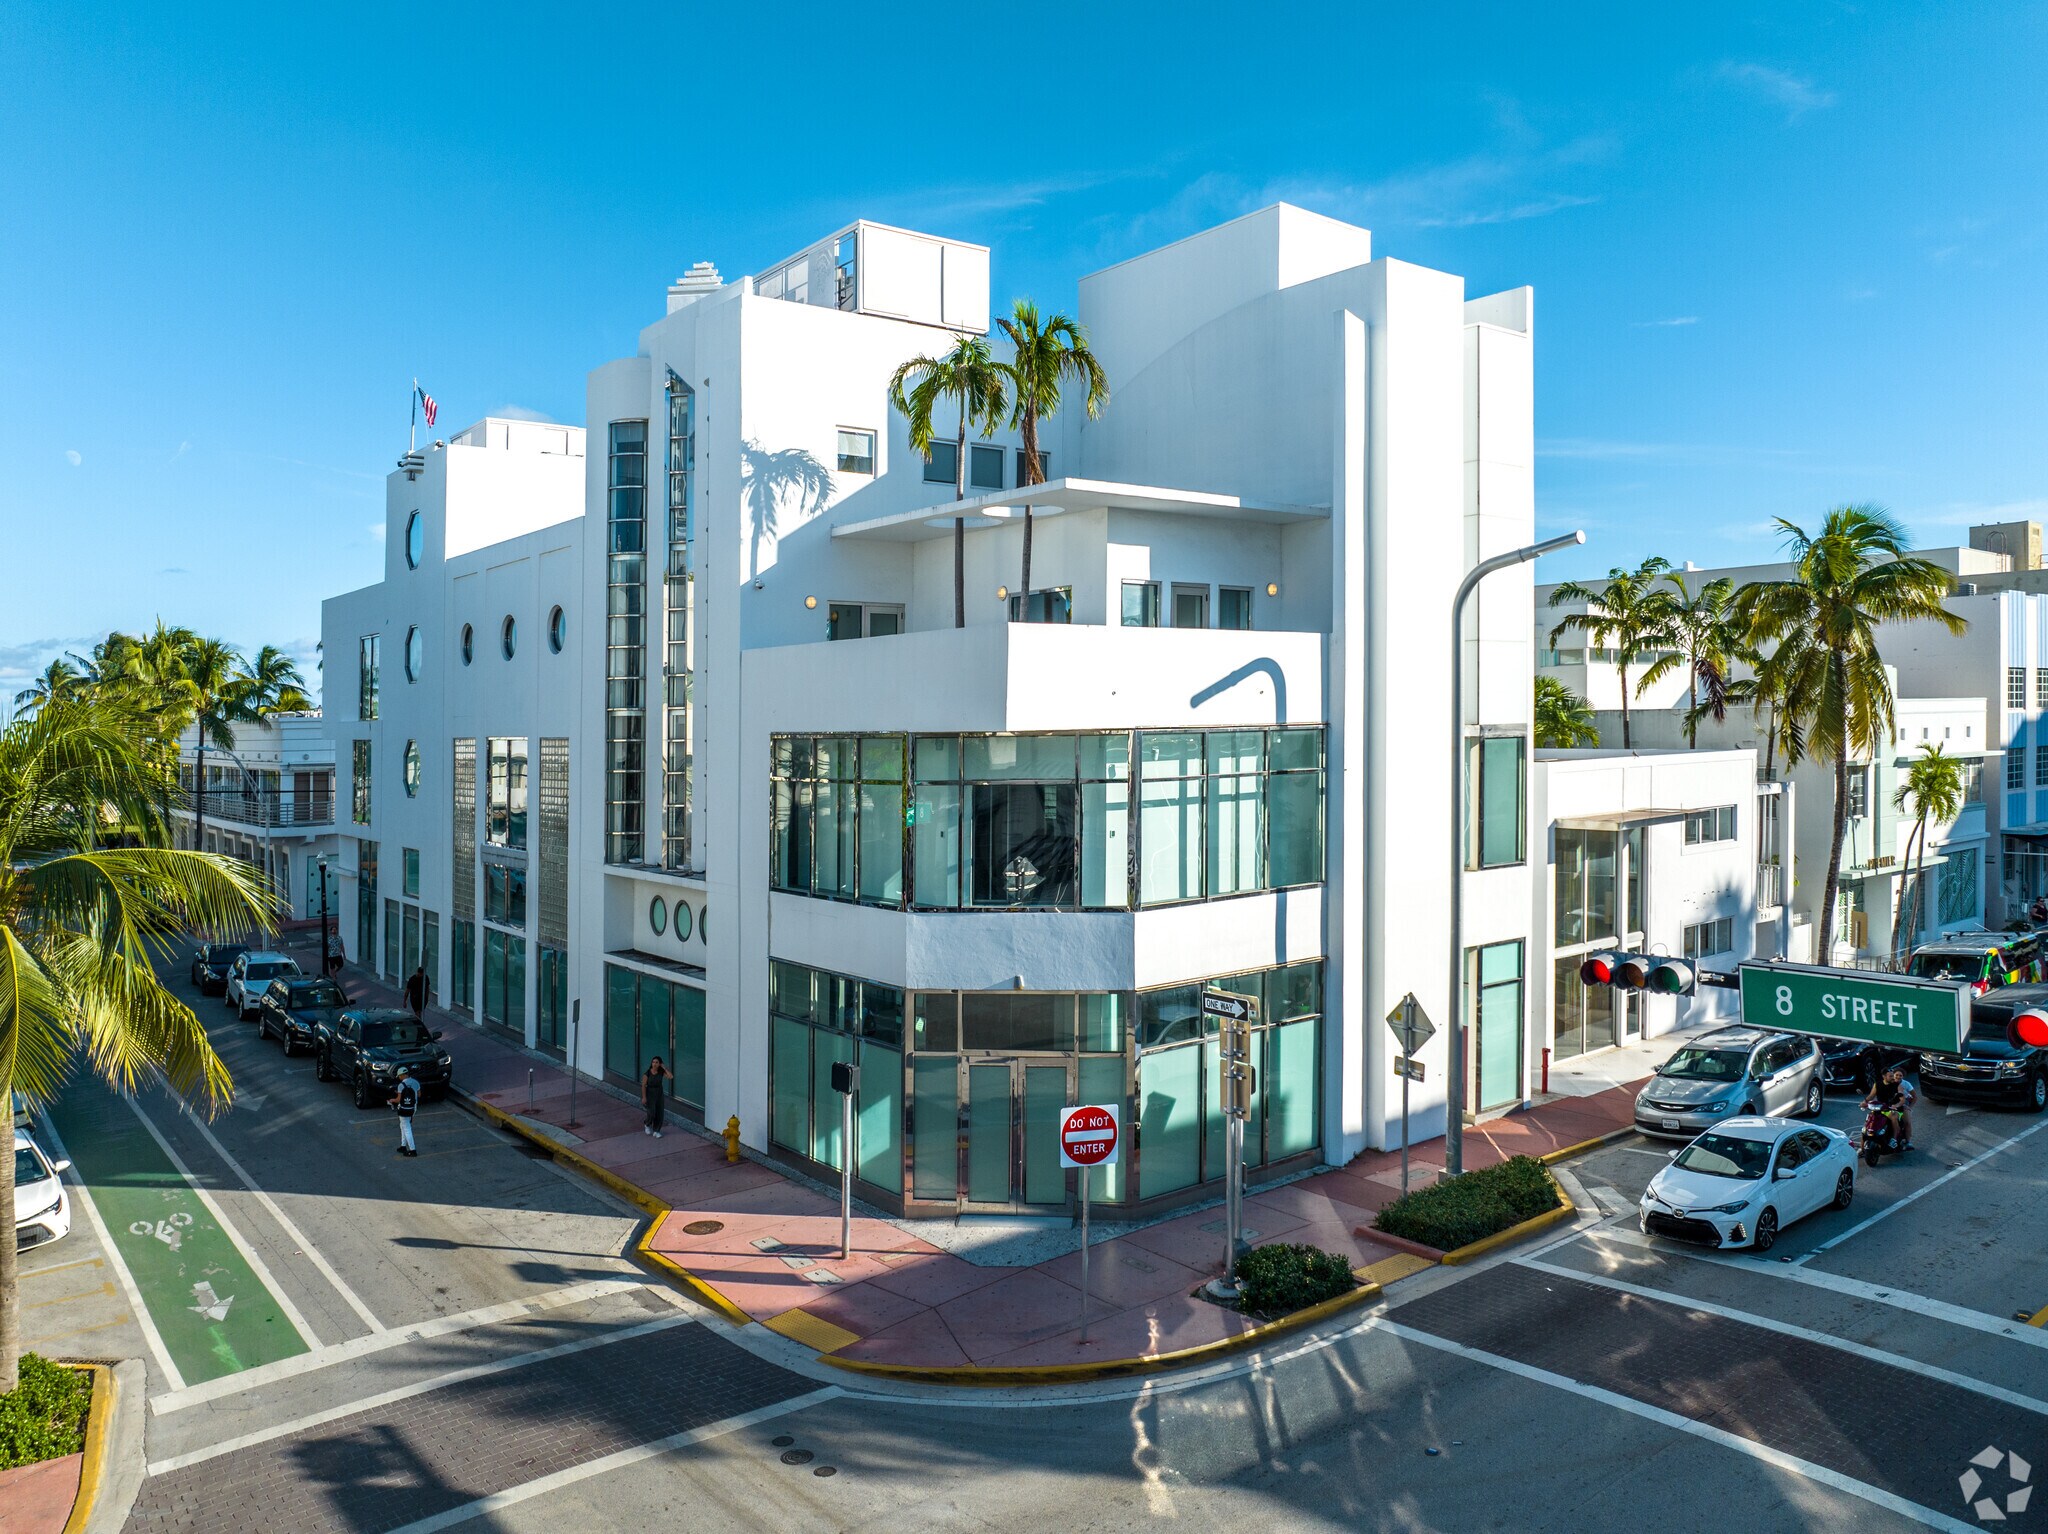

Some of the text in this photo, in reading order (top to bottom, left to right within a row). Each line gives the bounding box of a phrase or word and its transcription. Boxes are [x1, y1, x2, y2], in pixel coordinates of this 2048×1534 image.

[1206, 999, 1234, 1012] ONE WAY
[1776, 985, 1918, 1029] 8 STREET
[1070, 1115, 1110, 1129] DO NOT
[1073, 1143, 1105, 1155] ENTER
